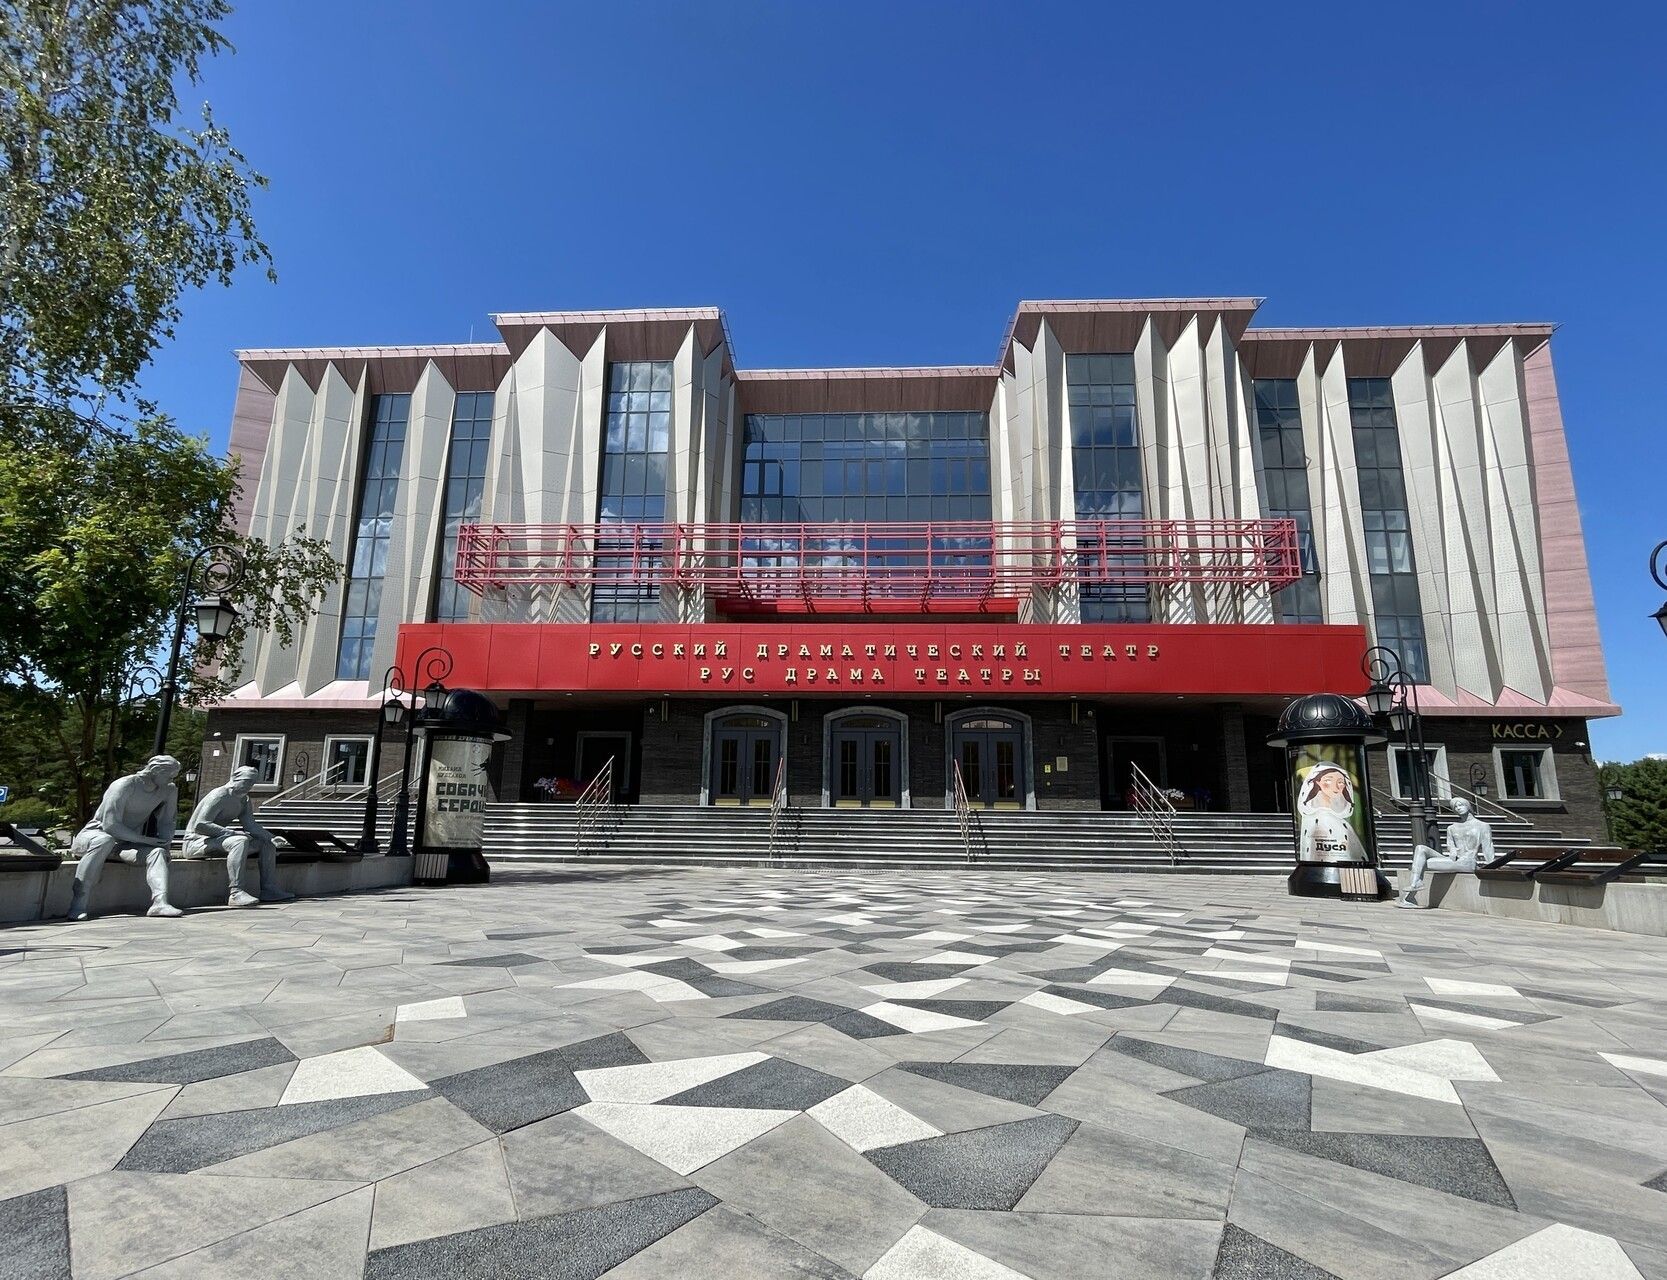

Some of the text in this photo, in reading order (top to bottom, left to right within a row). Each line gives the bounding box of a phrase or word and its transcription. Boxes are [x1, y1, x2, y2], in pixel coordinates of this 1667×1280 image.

[589, 641, 1159, 657] РУССКИЙ ДРАМАТИЧЕСКИЙ ТЕАТР
[700, 667, 1041, 682] РУС ДРАМА ТЕАТРЫ
[1491, 723, 1550, 738] КАССА
[1315, 842, 1347, 852] Дуся
